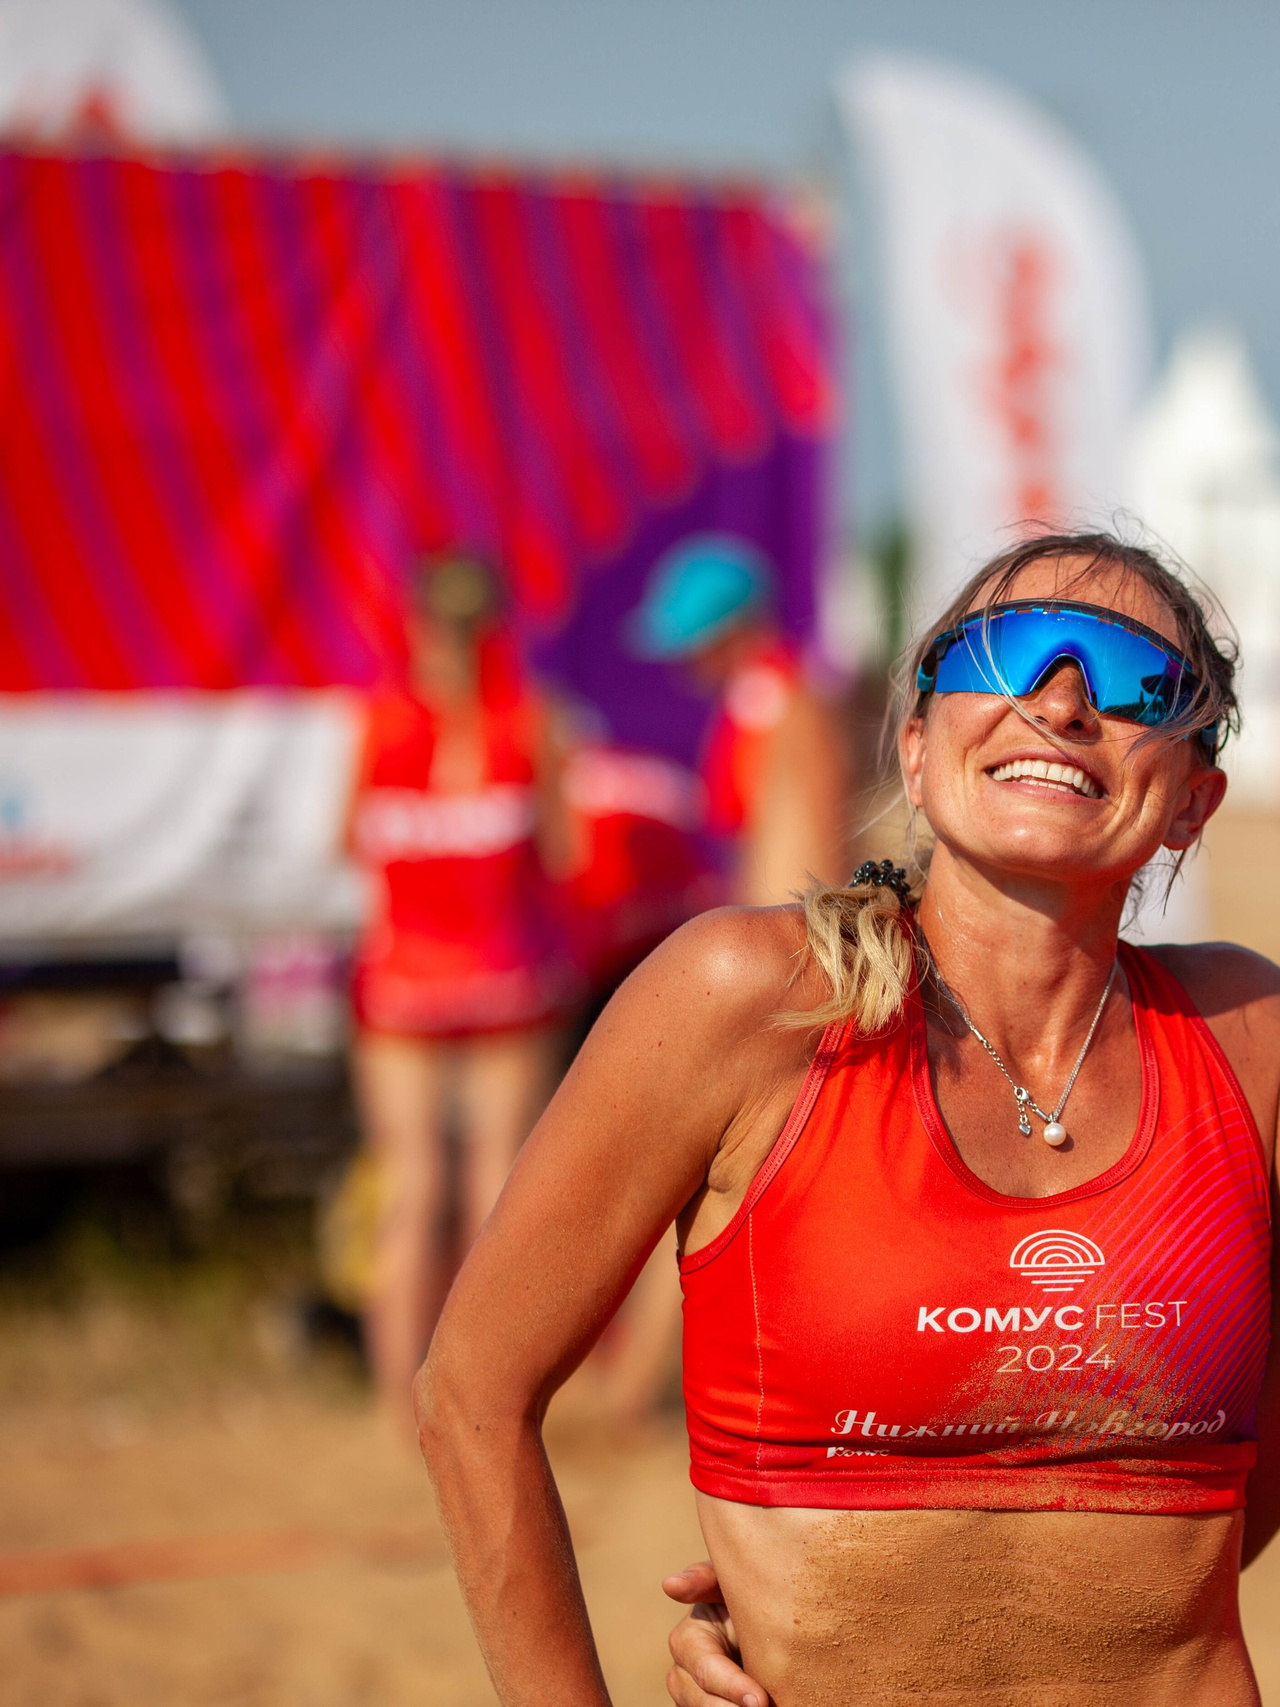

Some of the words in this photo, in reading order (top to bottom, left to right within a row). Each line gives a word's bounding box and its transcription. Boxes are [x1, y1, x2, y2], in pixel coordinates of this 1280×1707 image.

[917, 1305, 1085, 1333] КОМУС
[1096, 1300, 1188, 1329] FEST
[996, 1344, 1116, 1373] 2024
[830, 1409, 1021, 1438] Нижний
